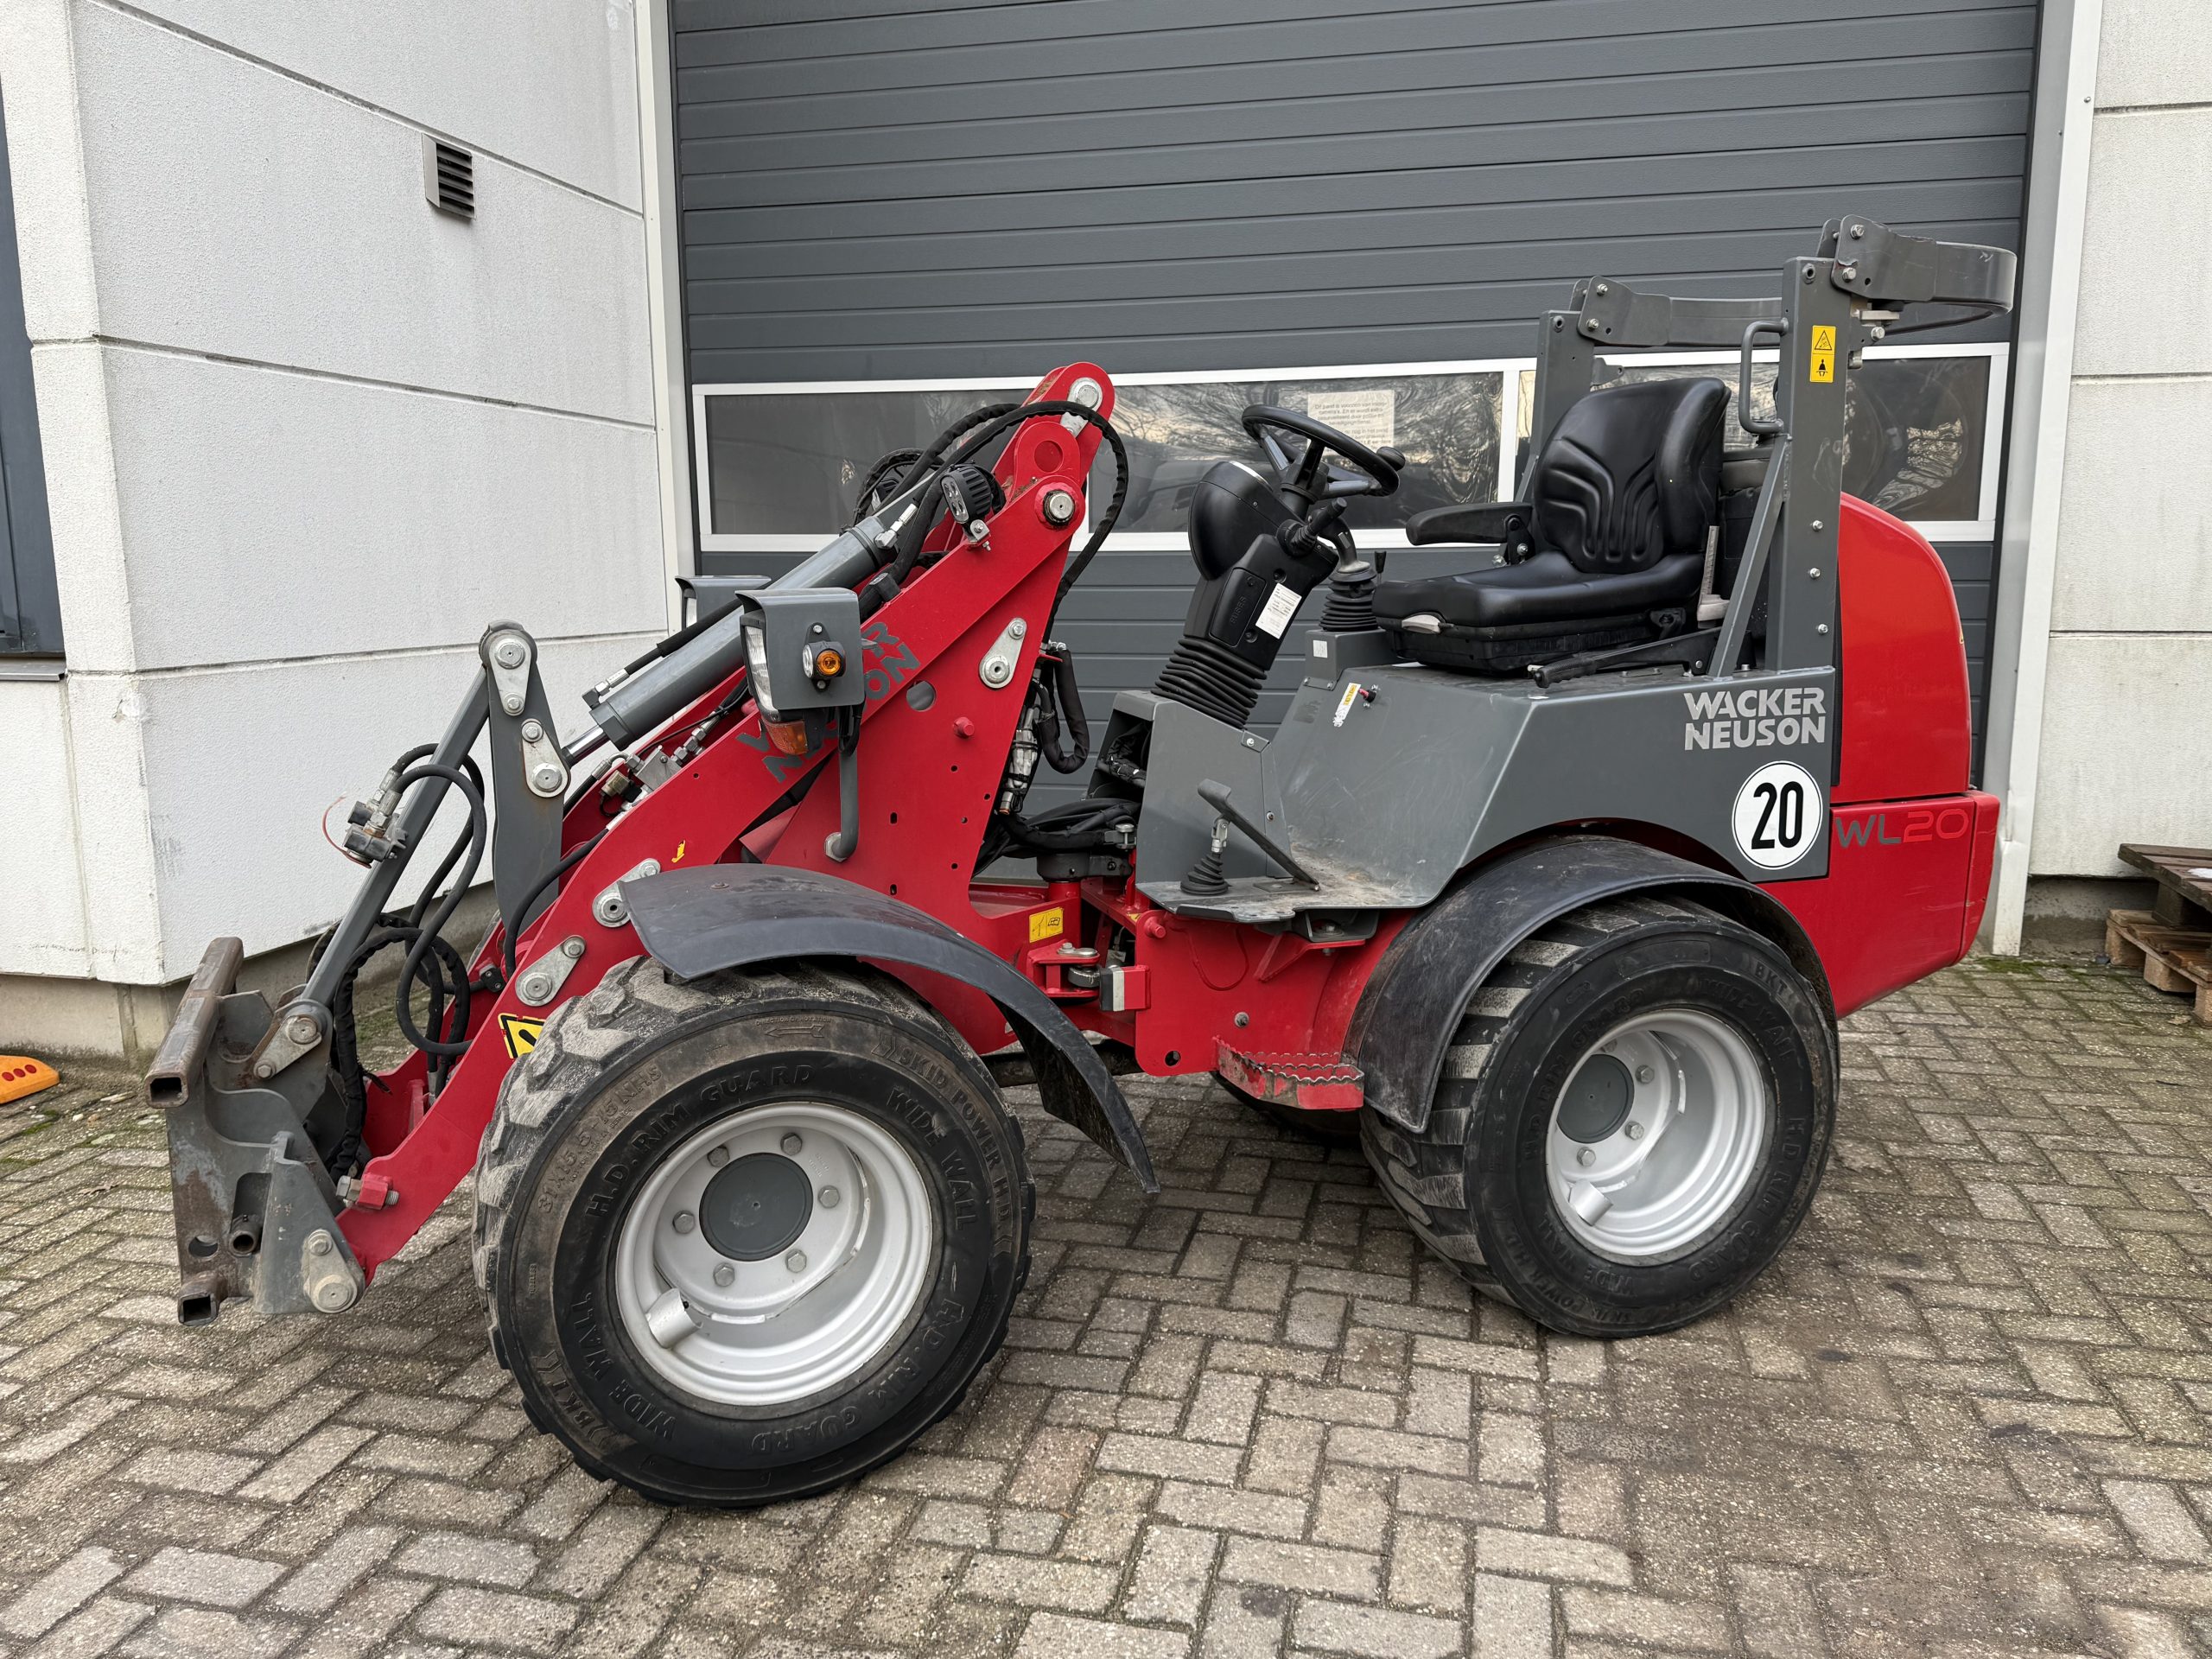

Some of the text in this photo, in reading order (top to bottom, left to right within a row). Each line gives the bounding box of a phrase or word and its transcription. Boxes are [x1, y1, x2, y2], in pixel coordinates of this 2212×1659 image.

[1684, 688, 1826, 720] WACKER
[1685, 716, 1826, 751] NEUSON
[1751, 781, 1804, 850] 20
[1835, 808, 1969, 849] WL20
[1754, 959, 1789, 996] BKT
[700, 1063, 816, 1104] GUARD
[899, 1047, 949, 1090] SKID
[950, 1089, 1003, 1168] POWER
[886, 1086, 977, 1231] WIDE WALL
